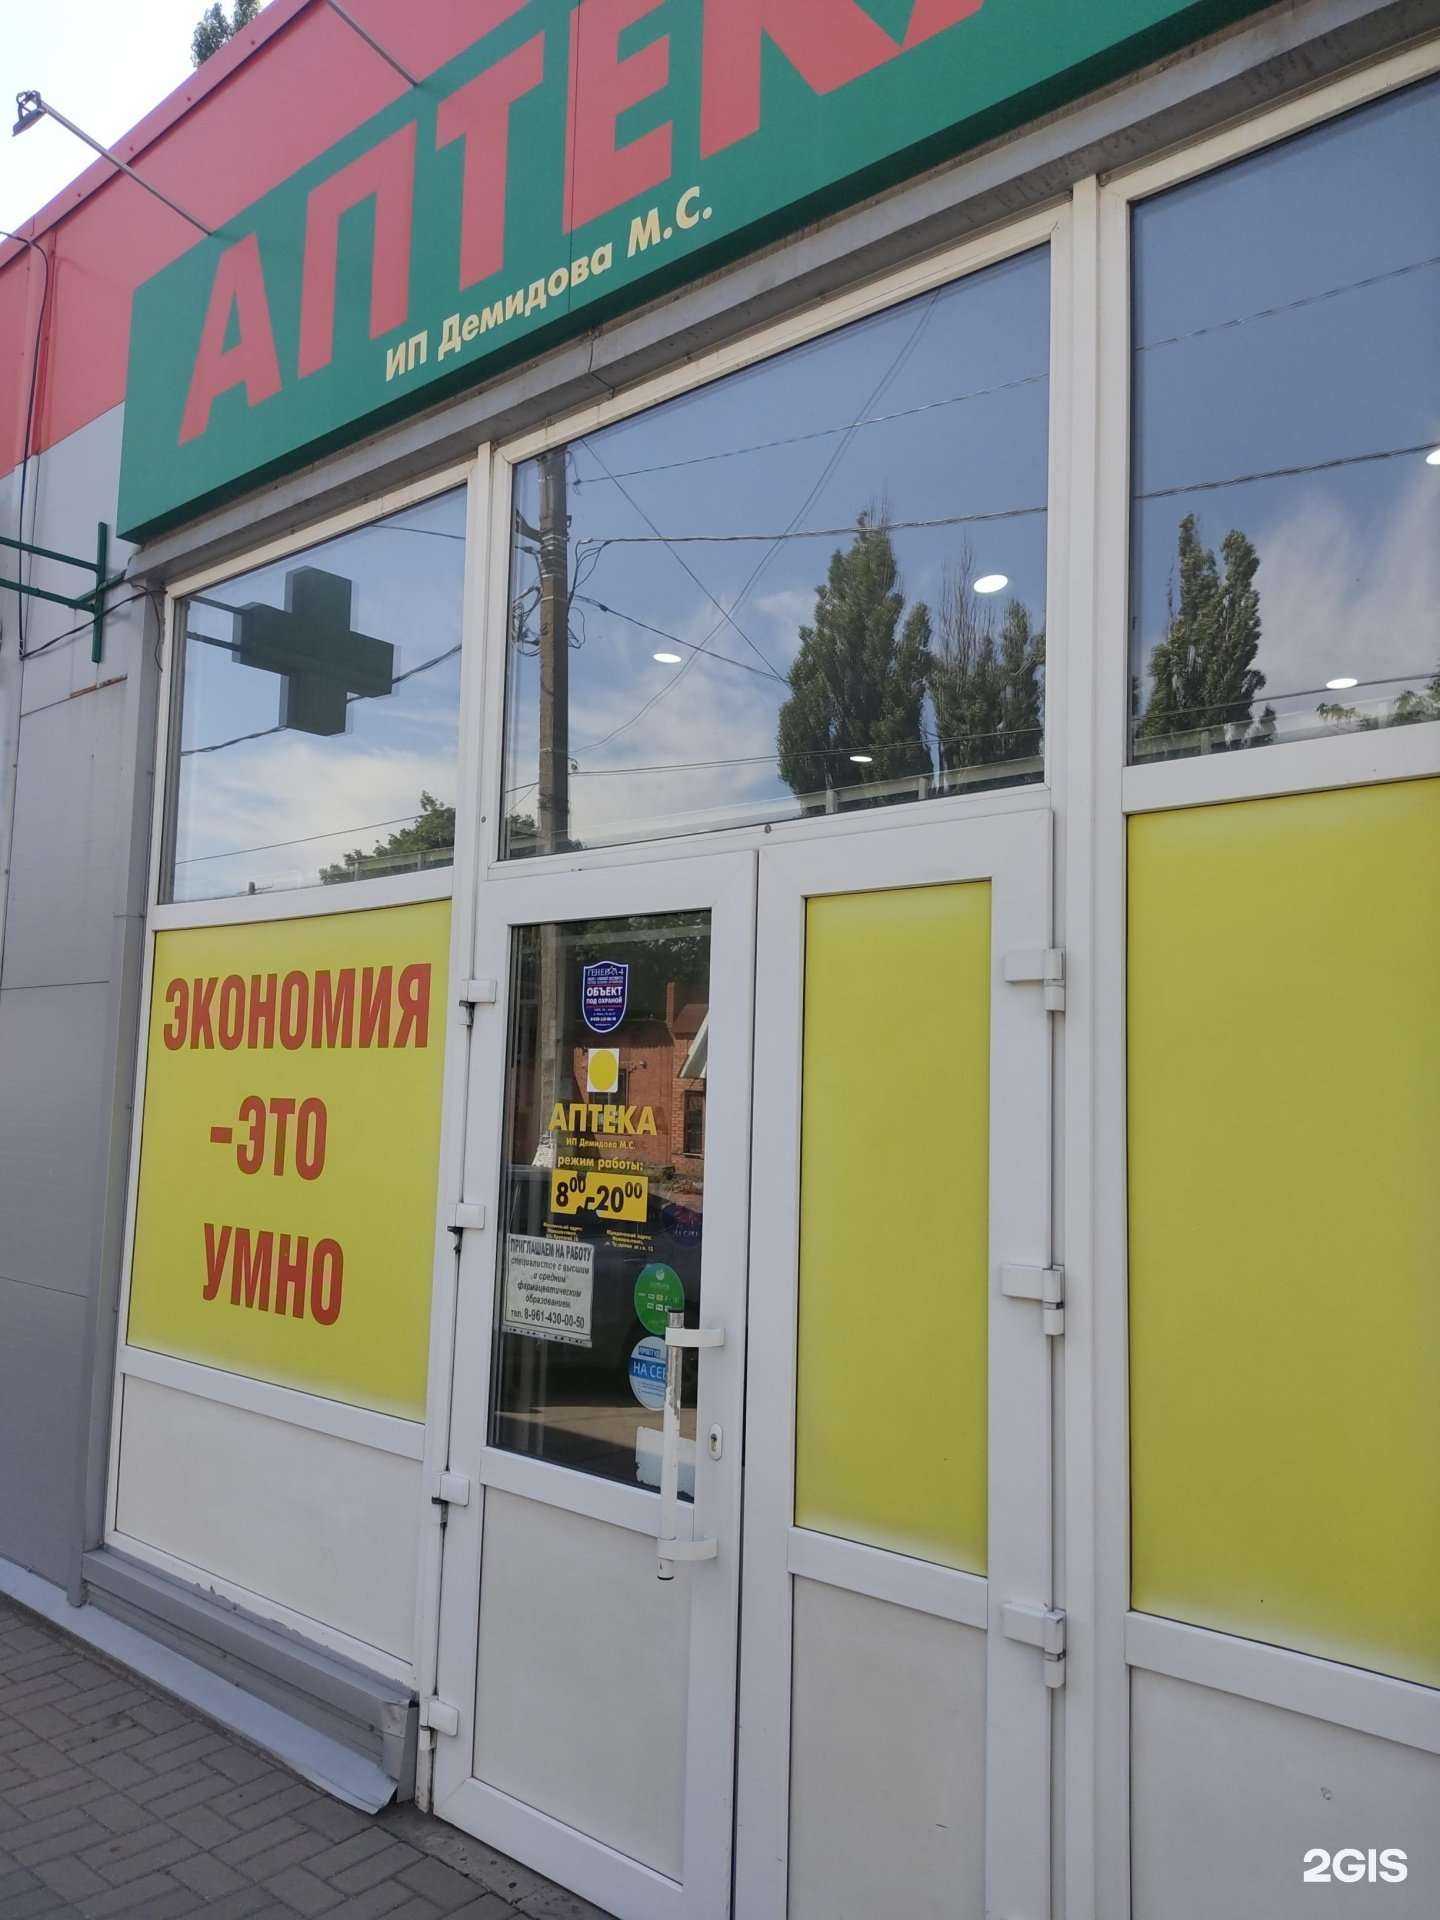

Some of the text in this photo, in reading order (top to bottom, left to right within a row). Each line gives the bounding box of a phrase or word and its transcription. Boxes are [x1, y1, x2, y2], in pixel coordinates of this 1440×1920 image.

[177, 0, 986, 447] АПТЕК
[385, 185, 713, 382] ИП Демидова М.С.
[163, 963, 433, 1051] ЭКОНОМИЯ
[586, 986, 623, 997] ОБЪЕКТ
[548, 1103, 657, 1136] АПТЕКА
[558, 1156, 643, 1171] режим работы:
[202, 1222, 345, 1326] УМНО
[510, 1238, 592, 1262] ПРИГЛАШАЕМ НА РАБОТУ
